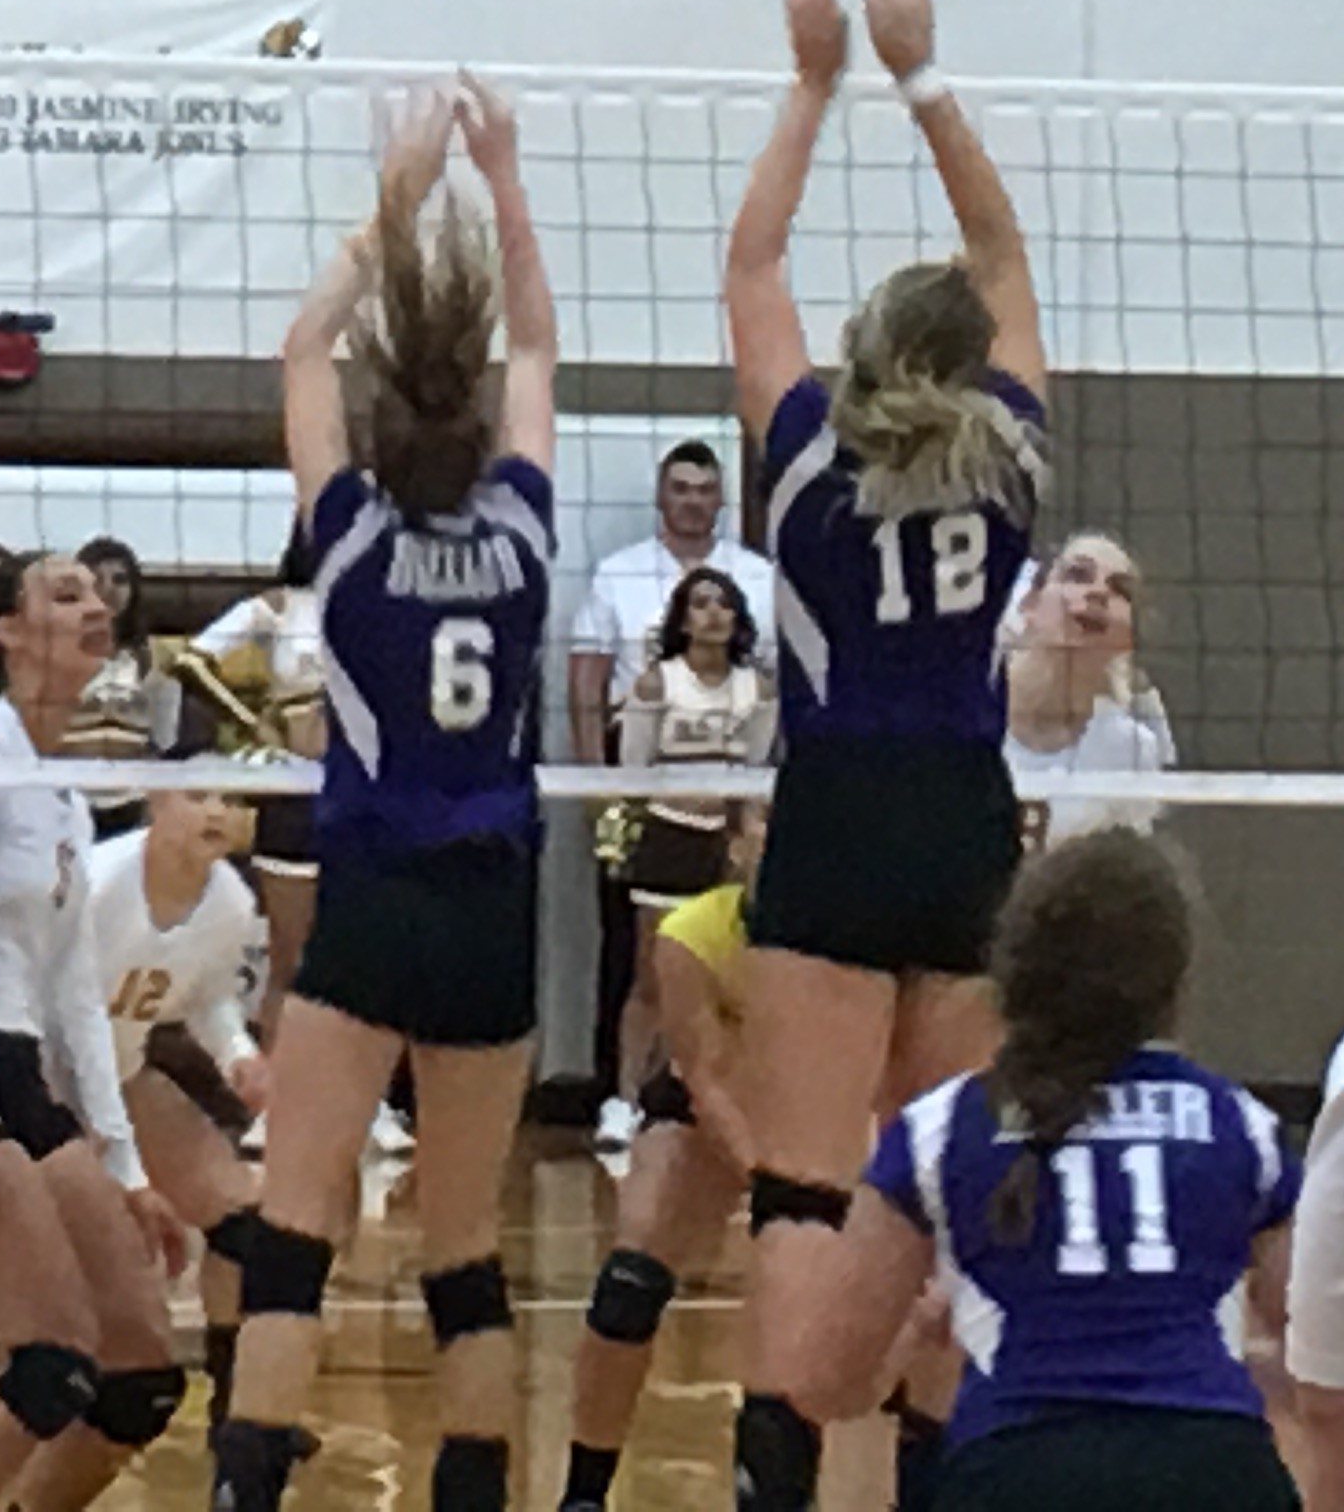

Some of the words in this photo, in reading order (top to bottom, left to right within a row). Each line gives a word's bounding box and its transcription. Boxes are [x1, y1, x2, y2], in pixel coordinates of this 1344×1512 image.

[25, 93, 158, 124] JASMINE
[172, 97, 282, 126] IRVING
[431, 615, 494, 732] 6
[107, 967, 172, 1022] 12
[1050, 1142, 1178, 1276] 11
